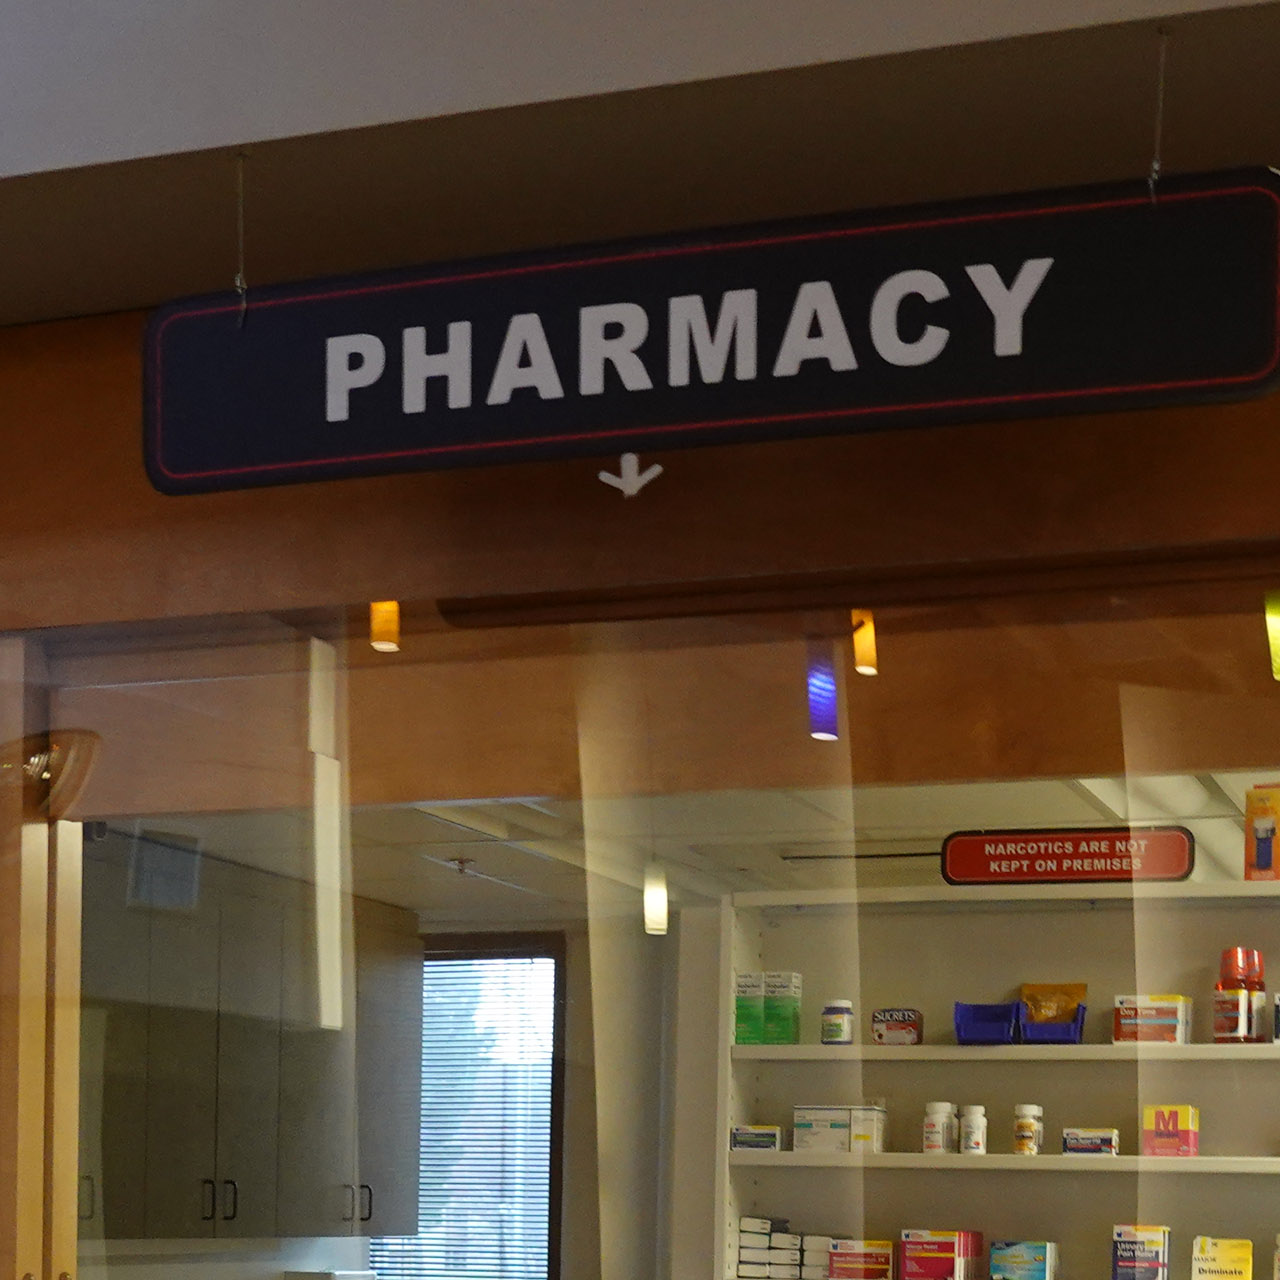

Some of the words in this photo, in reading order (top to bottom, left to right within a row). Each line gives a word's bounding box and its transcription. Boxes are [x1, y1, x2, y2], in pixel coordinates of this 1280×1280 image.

[325, 256, 1054, 422] PHARMACY
[984, 840, 1075, 856] NARCOTICS
[1078, 840, 1111, 854] ARE
[1115, 839, 1148, 853] NOT
[989, 859, 1031, 874] KEPT
[1035, 859, 1057, 873] ON
[1062, 857, 1143, 872] PREMISES
[873, 1009, 917, 1022] SUCRETS
[1120, 1008, 1135, 1017] Day
[1137, 1008, 1157, 1016] Time
[1193, 1256, 1217, 1264] MAJOR
[1198, 1268, 1243, 1277] Driminate
